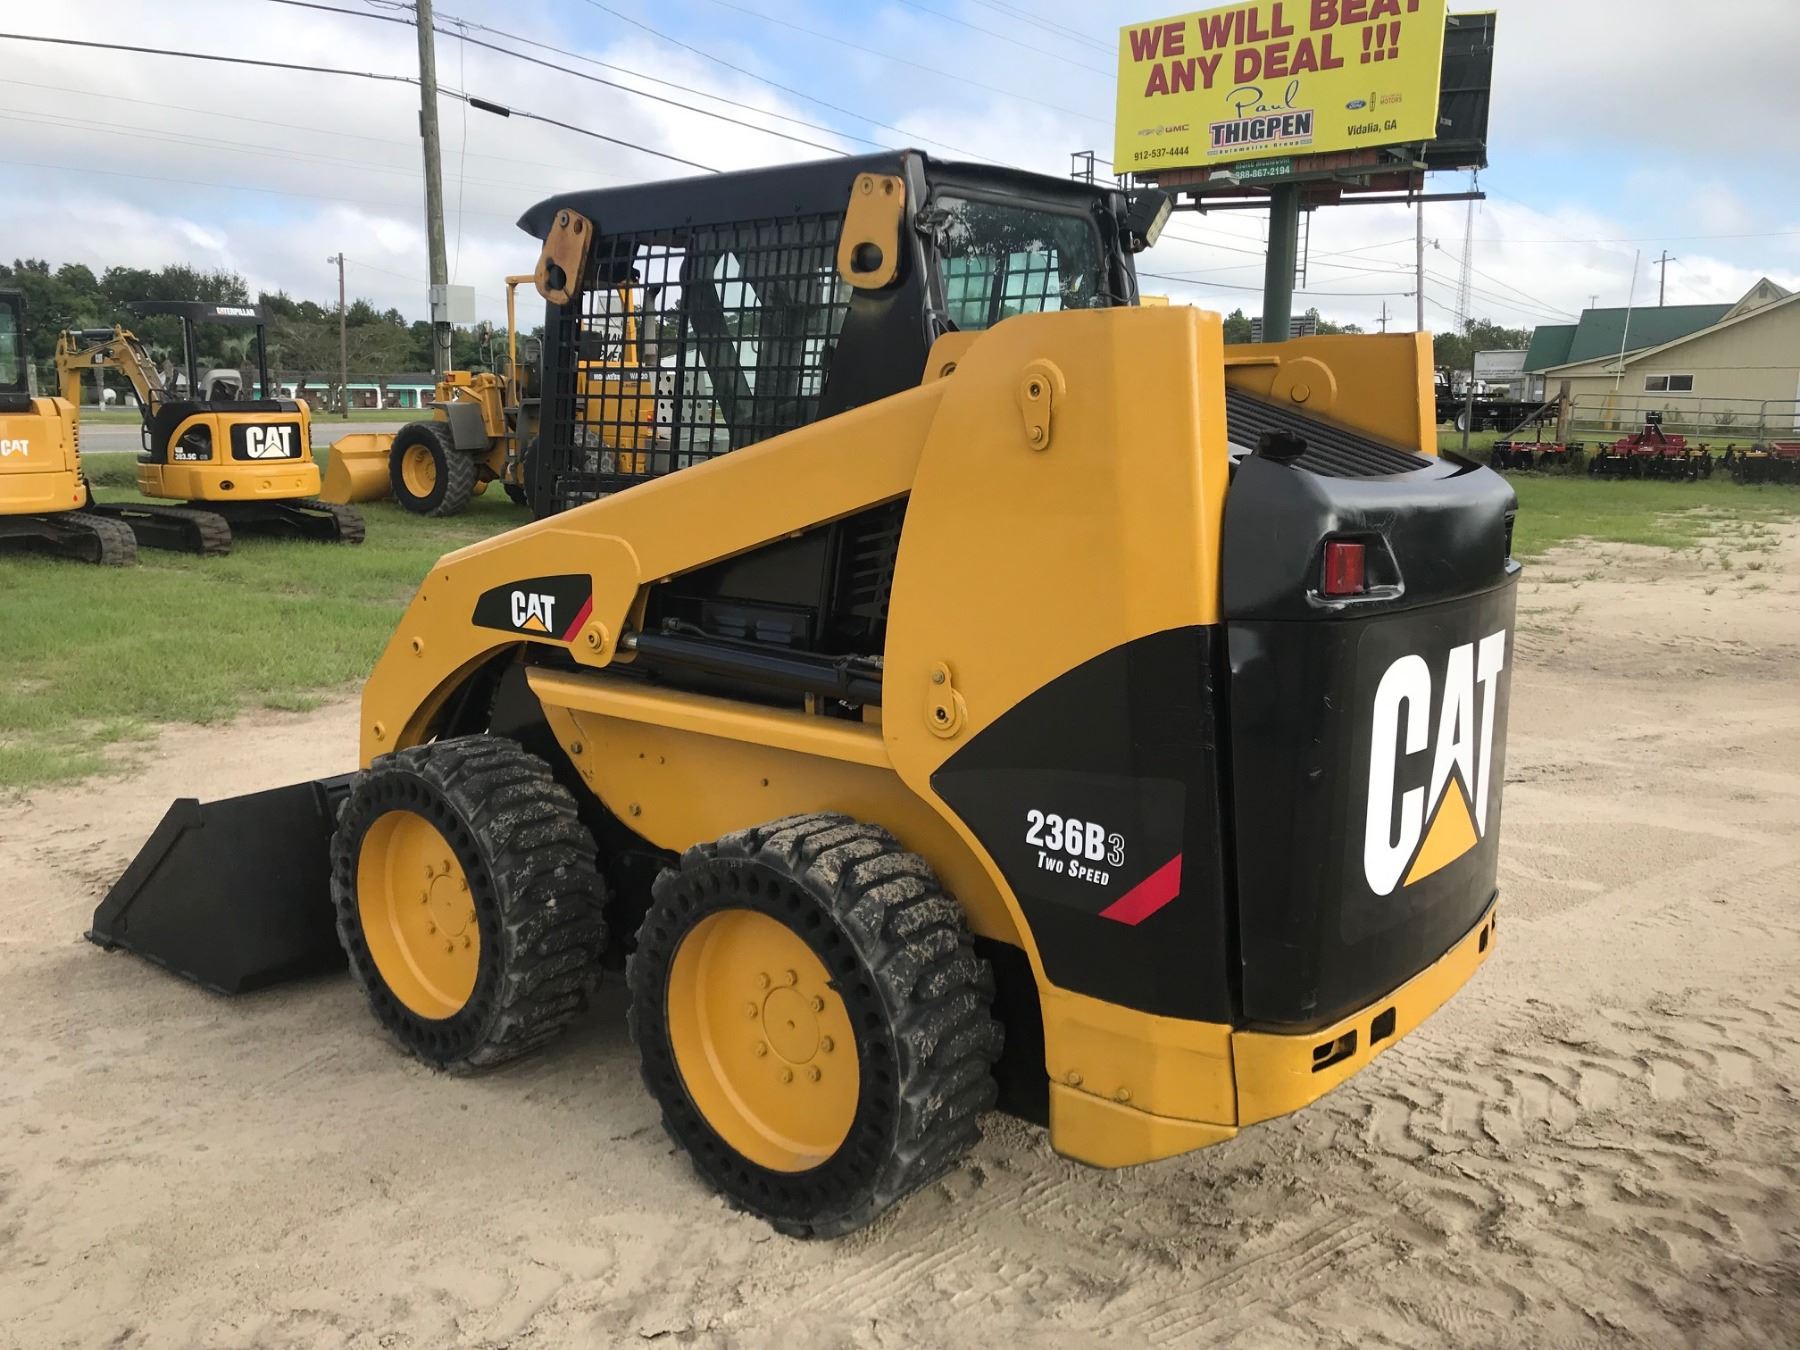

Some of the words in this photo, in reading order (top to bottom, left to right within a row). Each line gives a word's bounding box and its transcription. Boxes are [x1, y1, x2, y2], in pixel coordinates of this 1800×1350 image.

[1129, 22, 1185, 62] WE
[1198, 2, 1294, 51] WILL
[1145, 53, 1223, 97] ANY
[1234, 33, 1344, 84] DEAL
[1360, 20, 1401, 64] !!!
[1226, 79, 1299, 118] Paul
[1165, 124, 1190, 133] GMC
[1210, 111, 1312, 146] THIGPEN
[1347, 123, 1381, 136] Vidalia,
[1384, 119, 1397, 130] GA
[1134, 146, 1189, 160] 912-537-4444
[1, 439, 29, 457] CAT
[246, 426, 292, 458] CAT
[511, 590, 555, 633] CAT
[1364, 629, 1505, 896] CAT
